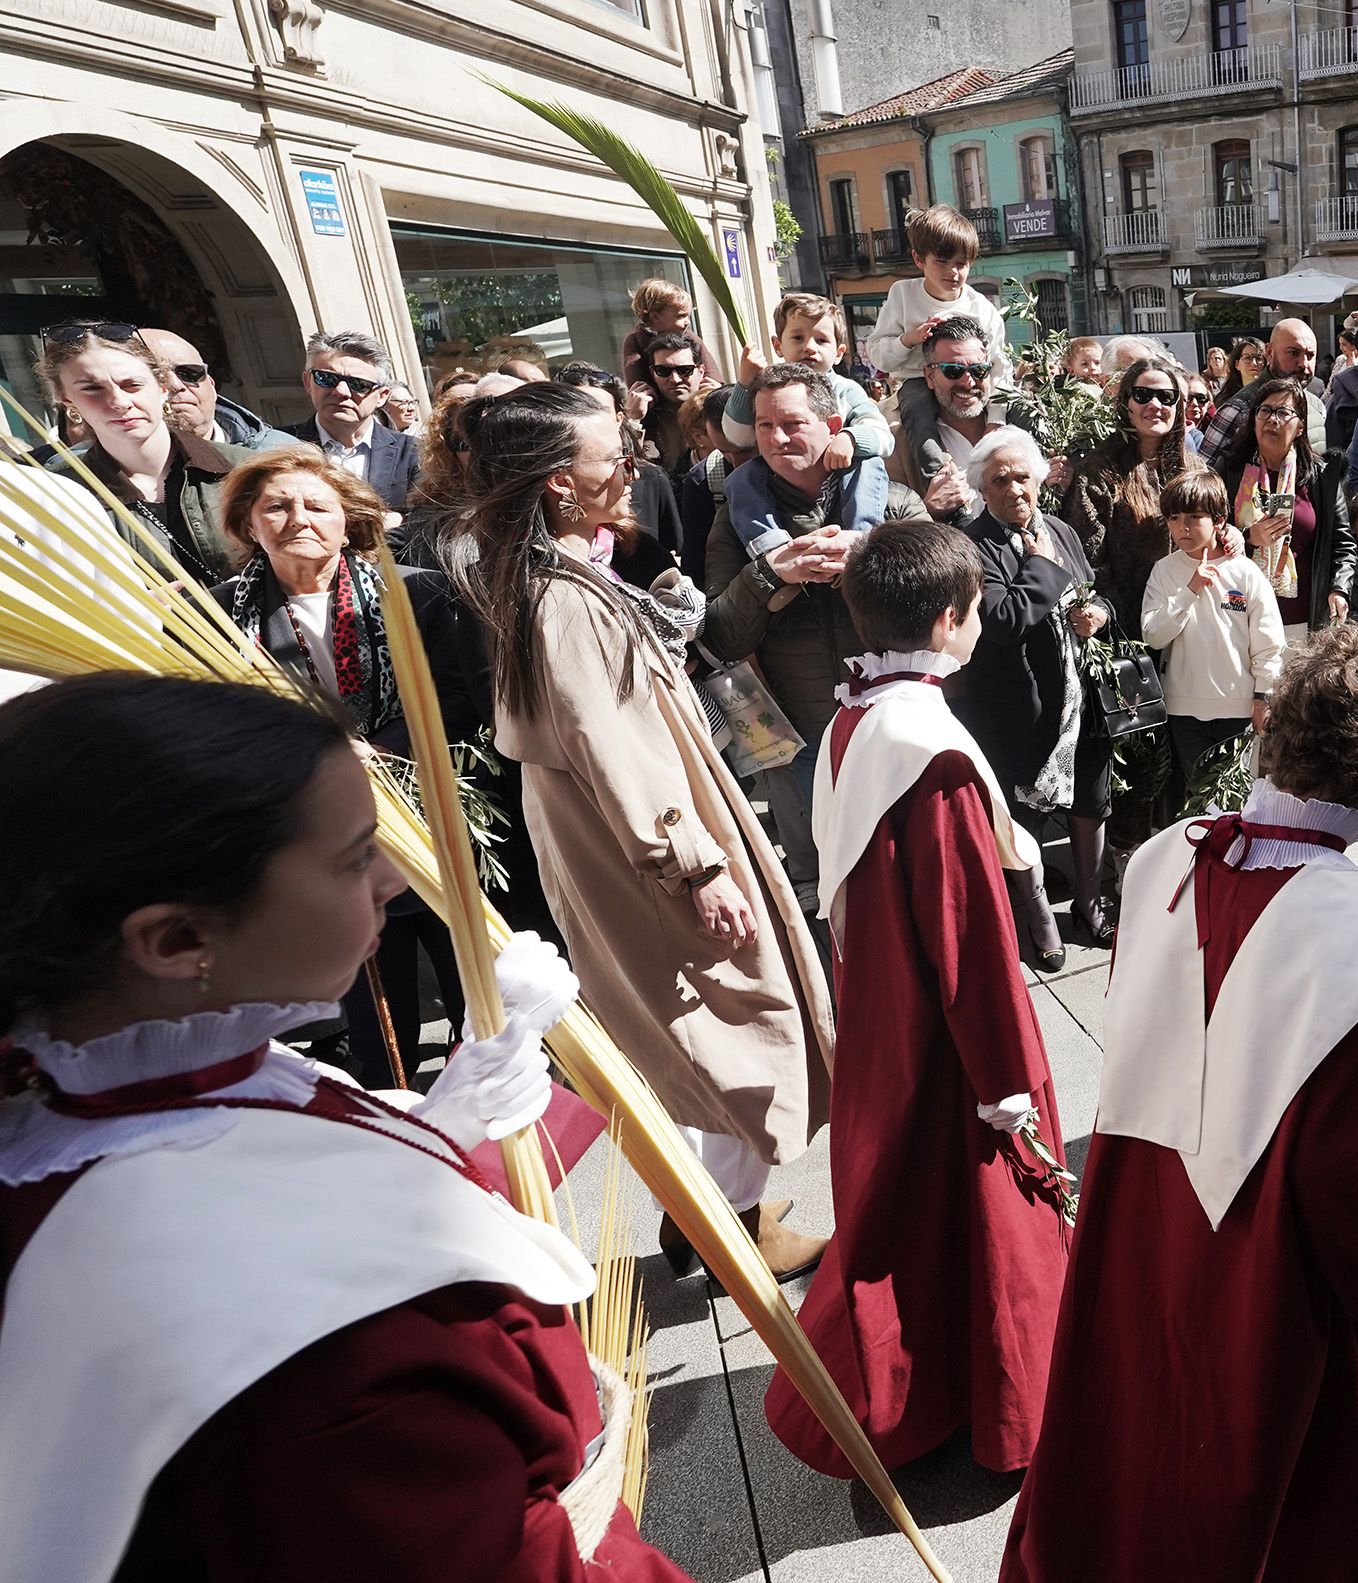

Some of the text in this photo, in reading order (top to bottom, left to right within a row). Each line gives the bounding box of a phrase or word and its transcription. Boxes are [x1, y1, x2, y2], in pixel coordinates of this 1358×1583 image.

[1013, 218, 1047, 233] VENDE
[1209, 271, 1228, 281] Nuria
[1229, 271, 1260, 283] Nogueira
